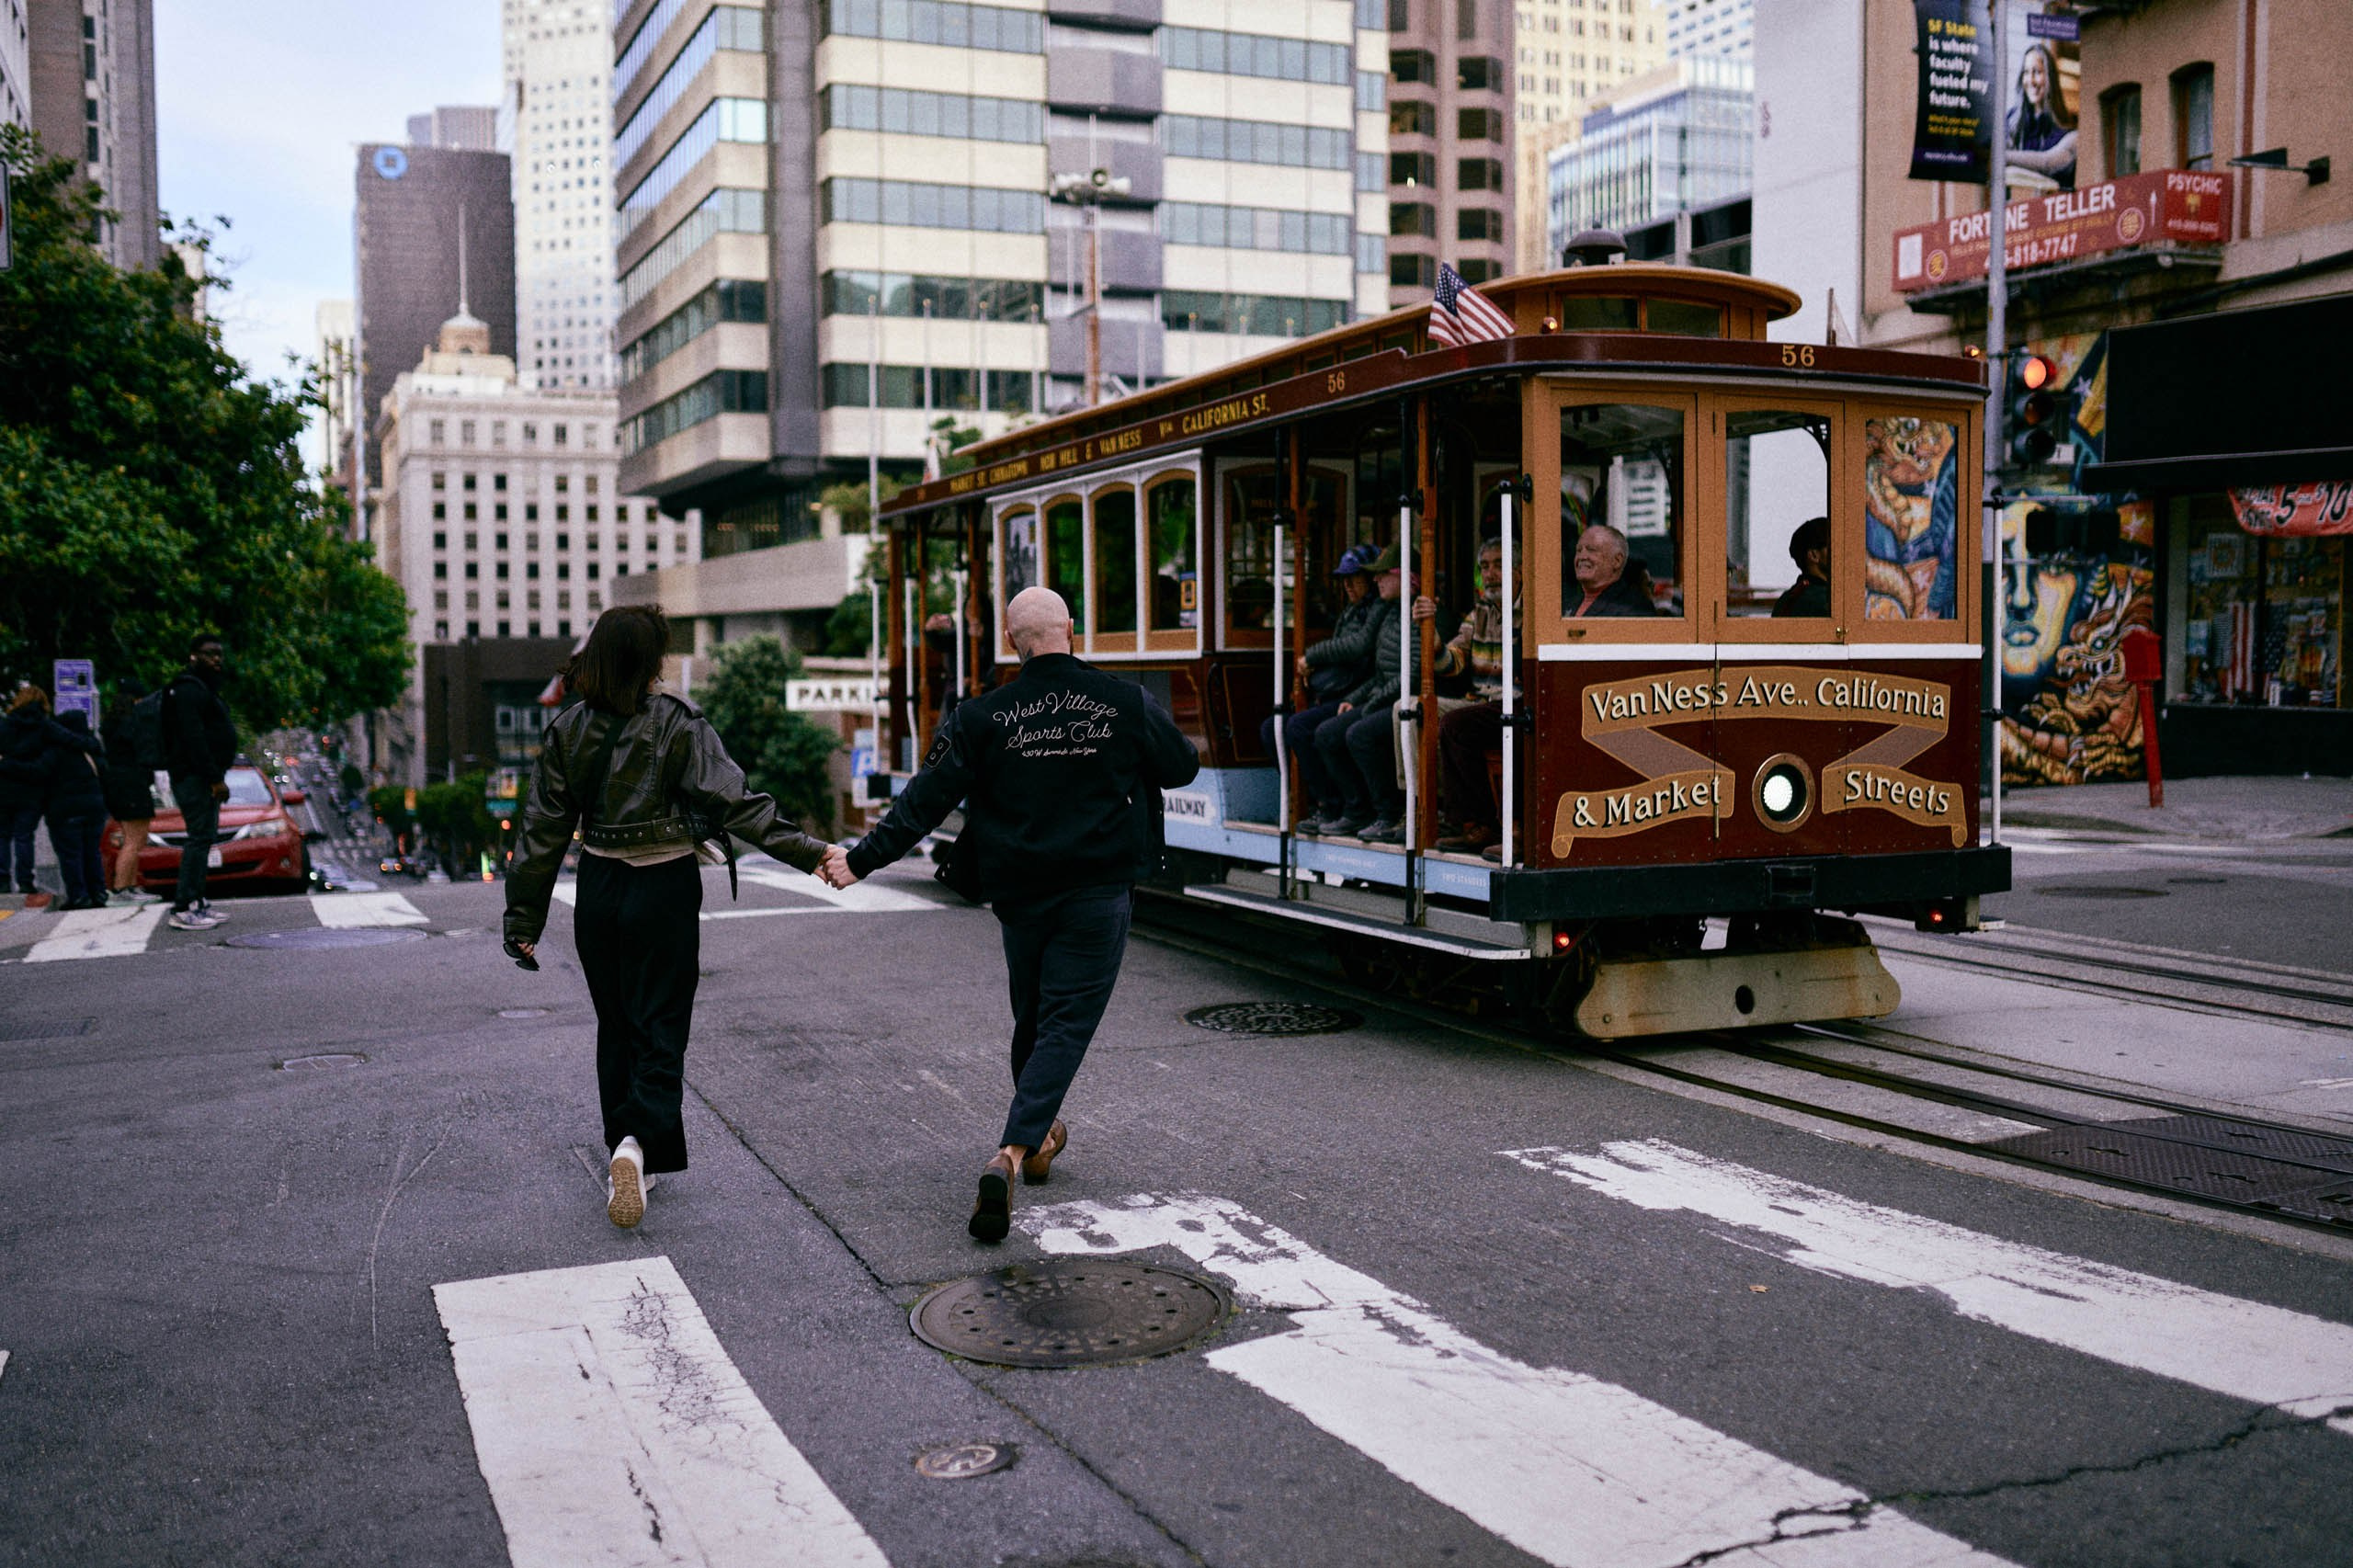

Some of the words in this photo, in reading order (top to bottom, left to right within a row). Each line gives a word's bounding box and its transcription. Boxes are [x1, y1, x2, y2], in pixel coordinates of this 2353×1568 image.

[1928, 18, 1943, 34] SF
[1945, 20, 1976, 38] State
[1929, 35, 1940, 51] is
[1941, 38, 1979, 55] where
[1929, 53, 1972, 74] faculty
[1929, 71, 1968, 89] fueled
[1970, 79, 1990, 96] my
[1929, 89, 1972, 108] future.
[2166, 173, 2222, 195] PSYCHIC
[2044, 184, 2117, 222] TELLER
[1781, 344, 1815, 368] 56
[1326, 370, 1347, 394] 56
[1182, 400, 1249, 435] CALIFORNIA
[1252, 392, 1271, 416] ST.
[993, 700, 1045, 727] West
[1045, 689, 1119, 721] Village
[1589, 689, 1648, 722] Van
[1653, 679, 1729, 714] Ness
[1815, 676, 1947, 721] California
[1005, 724, 1066, 750] Sports
[1067, 720, 1114, 743] Club
[1573, 796, 1598, 828] &
[1604, 775, 1722, 827] Market
[1844, 769, 1950, 814] Streets
